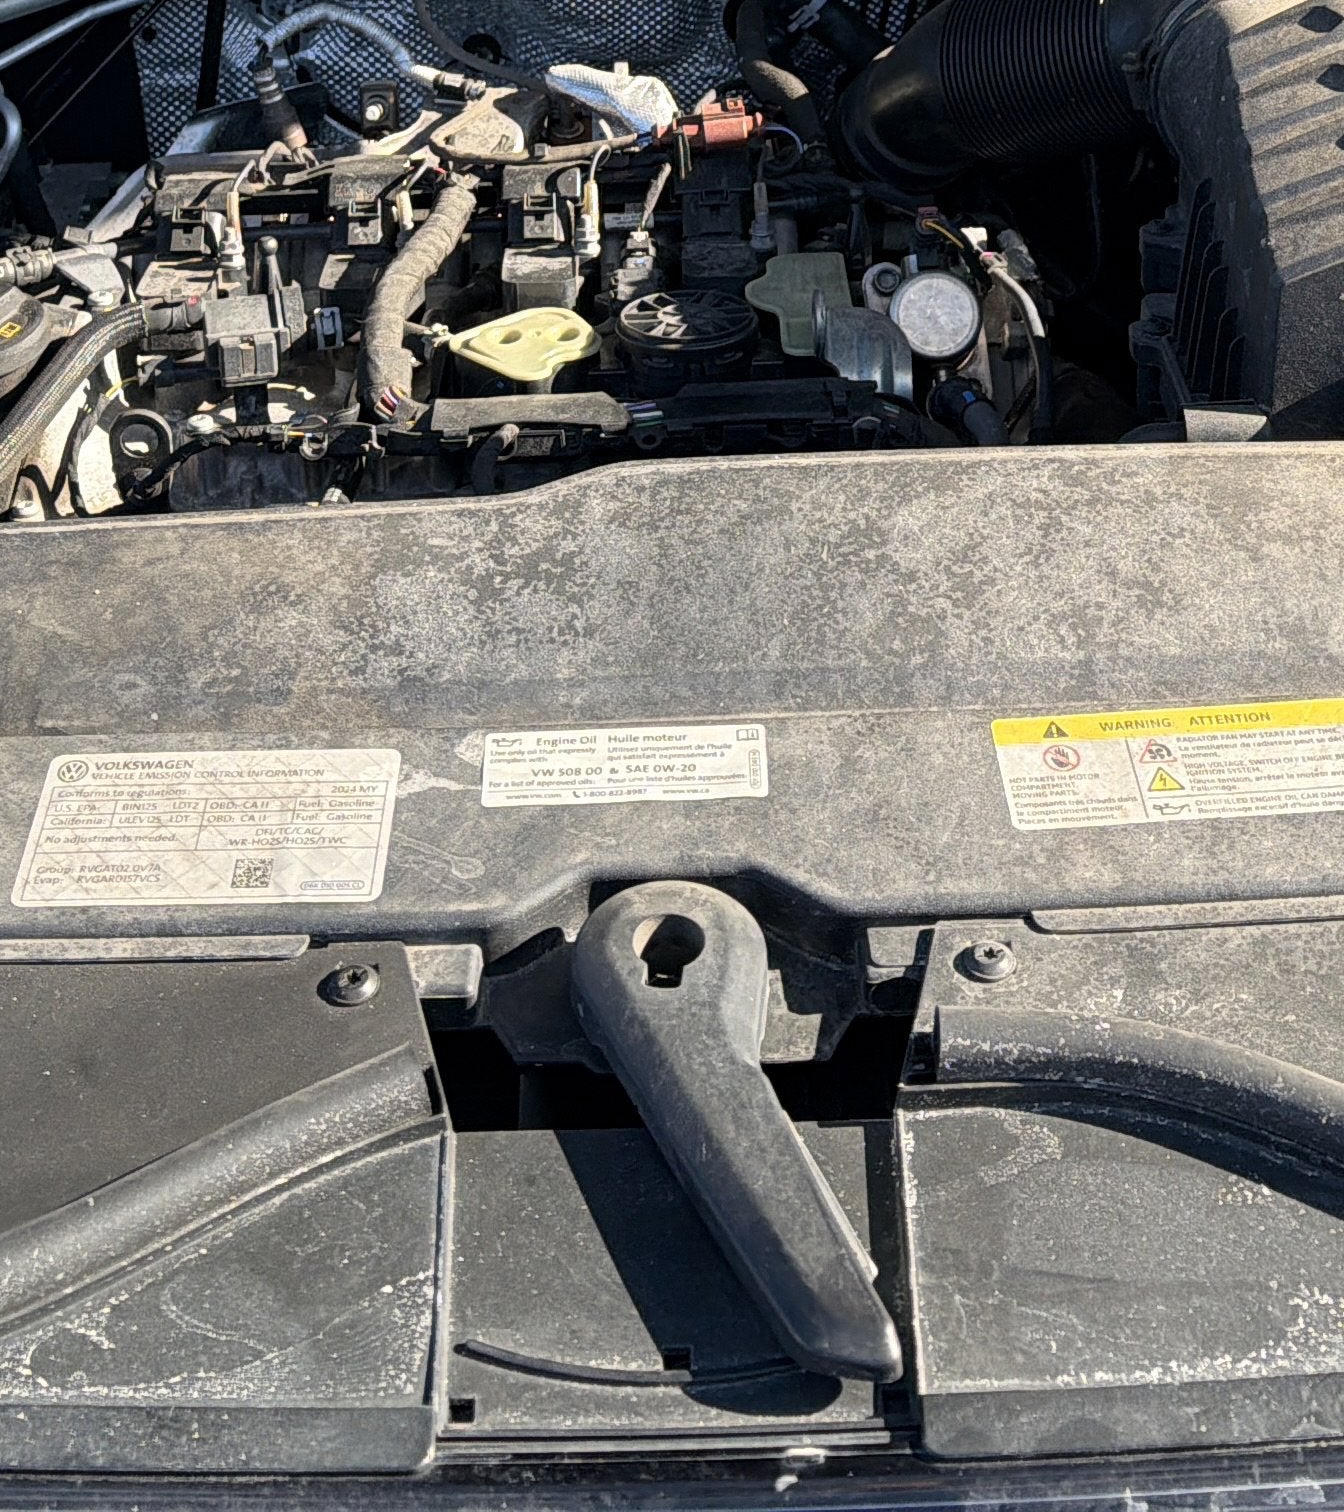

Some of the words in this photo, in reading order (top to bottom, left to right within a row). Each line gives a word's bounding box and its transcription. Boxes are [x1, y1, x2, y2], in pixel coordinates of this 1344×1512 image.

[1189, 712, 1271, 726] ATTENTION
[536, 737, 577, 747] Engine
[580, 735, 596, 744] Oil
[608, 734, 640, 743] Huile
[1176, 735, 1217, 743] RADIATOR
[1259, 730, 1285, 738] START
[1192, 743, 1237, 751] ventilateur
[1253, 739, 1293, 749] radiateur
[1295, 738, 1313, 746] peut
[96, 760, 195, 770] VOLKSWAGEN
[1248, 758, 1281, 766] SWITCH
[1302, 754, 1332, 762] ENGINE
[92, 772, 135, 780] VEHICLE
[138, 771, 191, 779] EMISSION
[248, 769, 325, 778] INFORMATION
[531, 769, 554, 777] VW
[559, 768, 581, 776] 508
[586, 767, 602, 775] 00
[626, 765, 649, 773] SAE
[653, 764, 696, 772] 0W-20
[537, 779, 576, 787] approved
[58, 789, 110, 798] Conforms
[127, 789, 191, 798] regulations:
[332, 785, 356, 793] 2024
[359, 785, 378, 793] MY
[122, 803, 157, 811] BIN125
[243, 801, 256, 809] CA
[329, 799, 375, 808] Gasoline
[1195, 797, 1248, 806] OVERFILLED
[1027, 807, 1089, 816] compartiment
[1198, 806, 1252, 814] Remplissage
[119, 816, 161, 824] ULEV125
[169, 815, 190, 823] LDT
[207, 815, 235, 823] OBD:
[296, 813, 320, 821] Fuel:
[327, 812, 373, 821] Gasoline
[1062, 814, 1118, 823] mouvement.
[45, 836, 59, 844] No
[63, 835, 132, 845] adjustments
[134, 834, 177, 842] needed.
[229, 836, 348, 846] WR-HO2S/HO2S/TWC
[37, 866, 74, 875] Group:
[34, 876, 63, 885] Evap:
